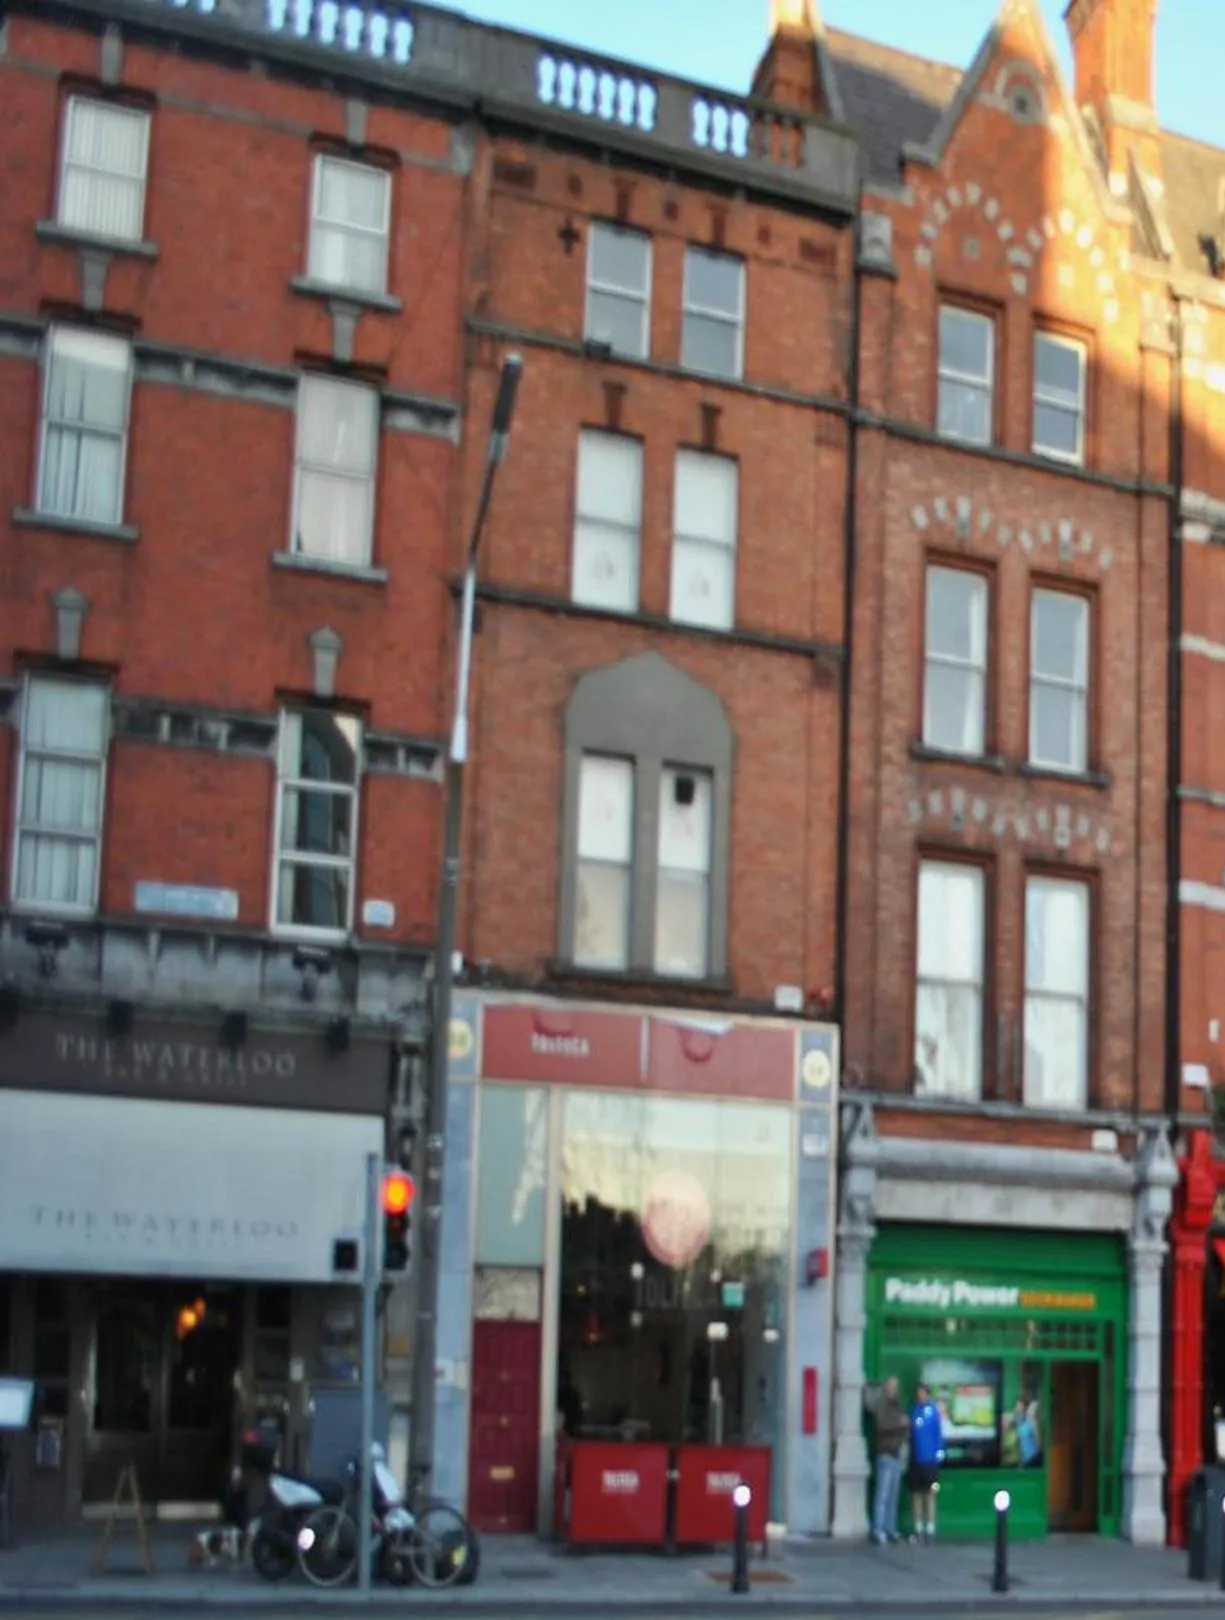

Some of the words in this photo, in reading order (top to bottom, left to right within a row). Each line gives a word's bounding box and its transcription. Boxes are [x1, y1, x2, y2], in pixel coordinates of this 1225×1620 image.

[57, 1031, 114, 1063] THE
[132, 1041, 297, 1077] WATERLOO
[29, 1205, 97, 1229] THE
[113, 1210, 299, 1238] WATERLOO
[885, 1277, 950, 1310] Paddy
[953, 1280, 1020, 1308] Power
